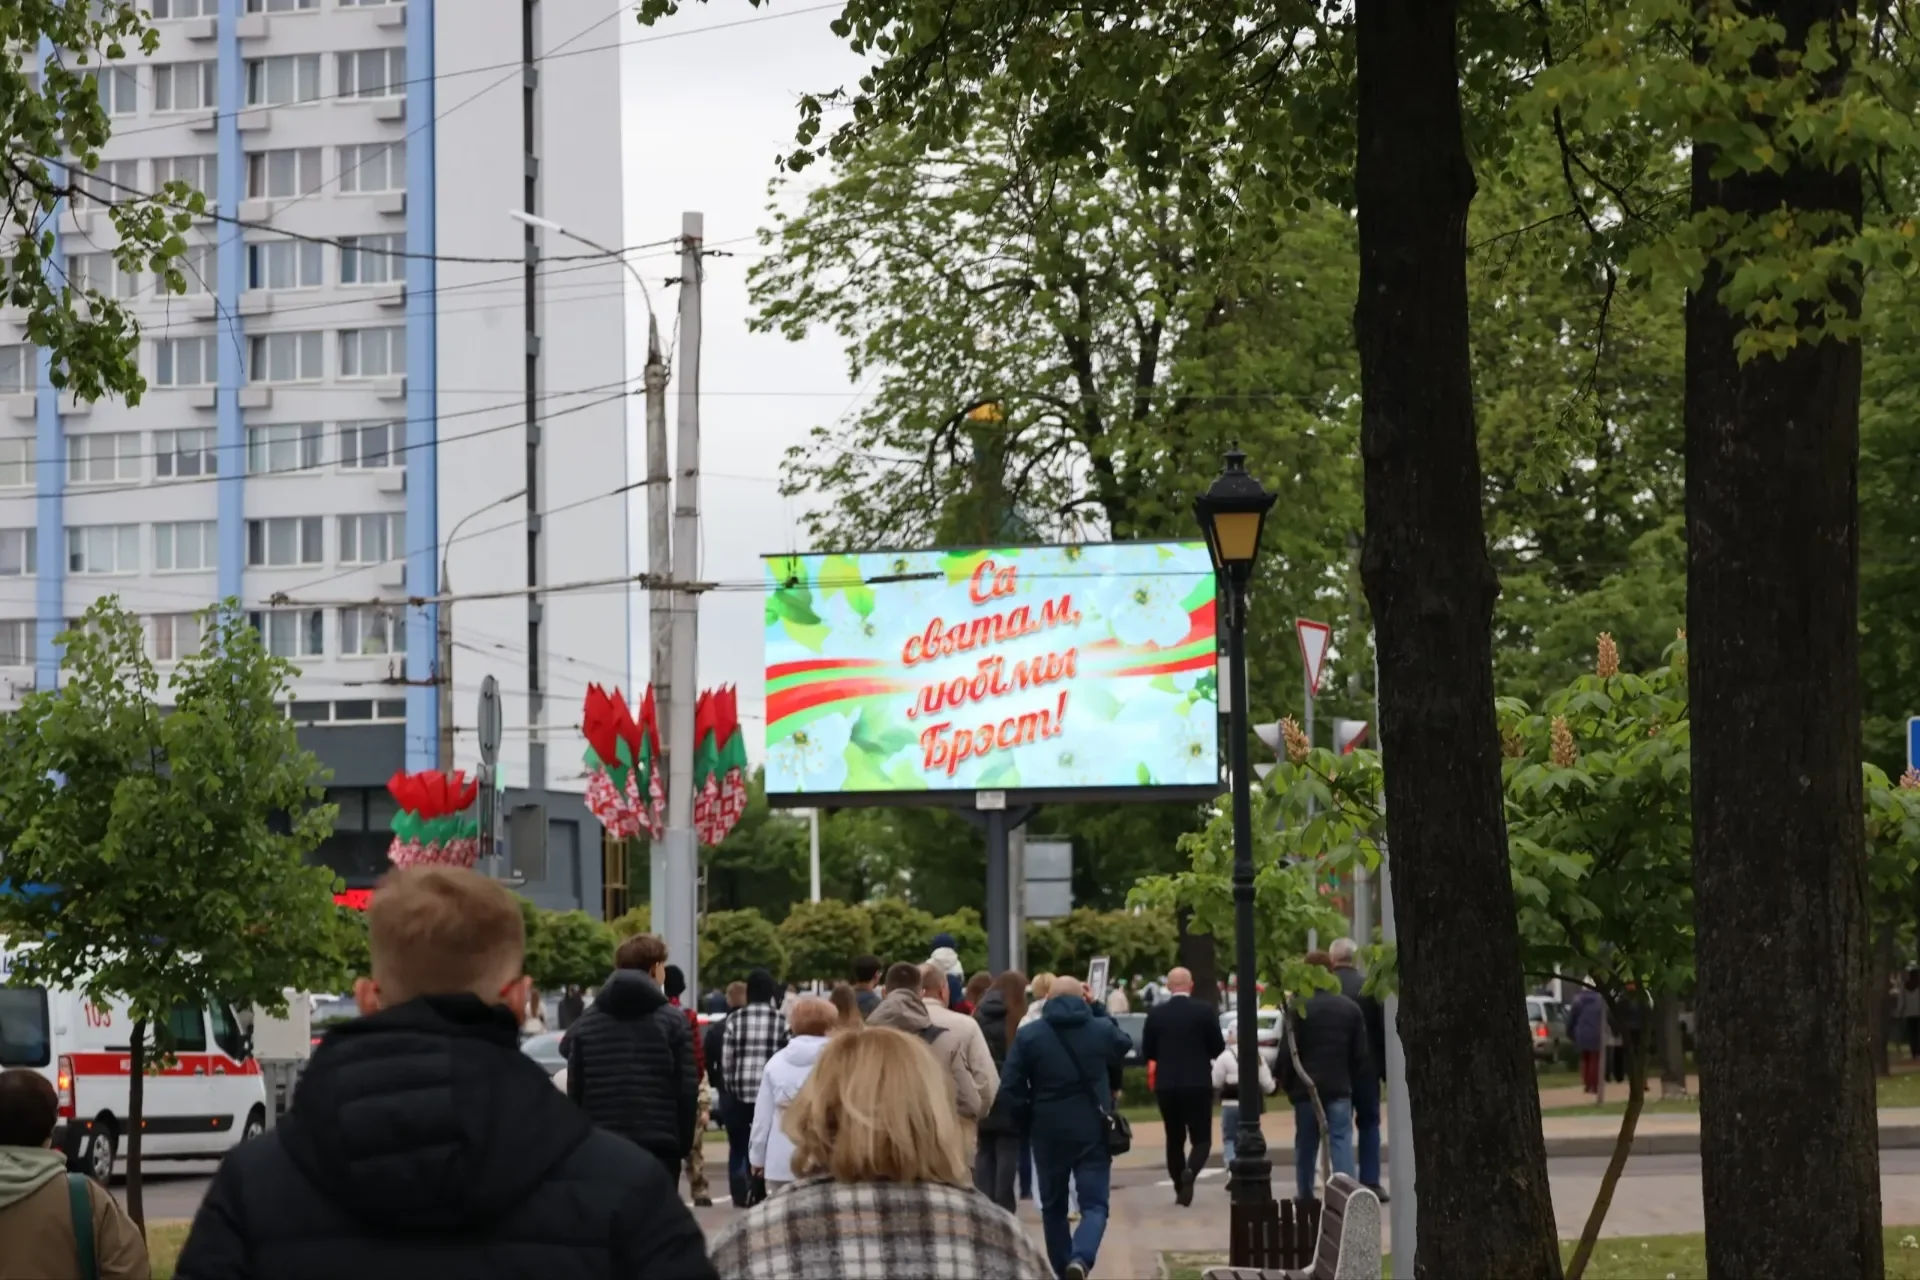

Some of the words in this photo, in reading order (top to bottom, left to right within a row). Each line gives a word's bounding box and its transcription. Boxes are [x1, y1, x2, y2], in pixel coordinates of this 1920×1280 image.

[969, 559, 1018, 604] Са
[902, 594, 1083, 666] святам,
[907, 647, 1077, 718] любімы
[920, 690, 1068, 776] Брэст!
